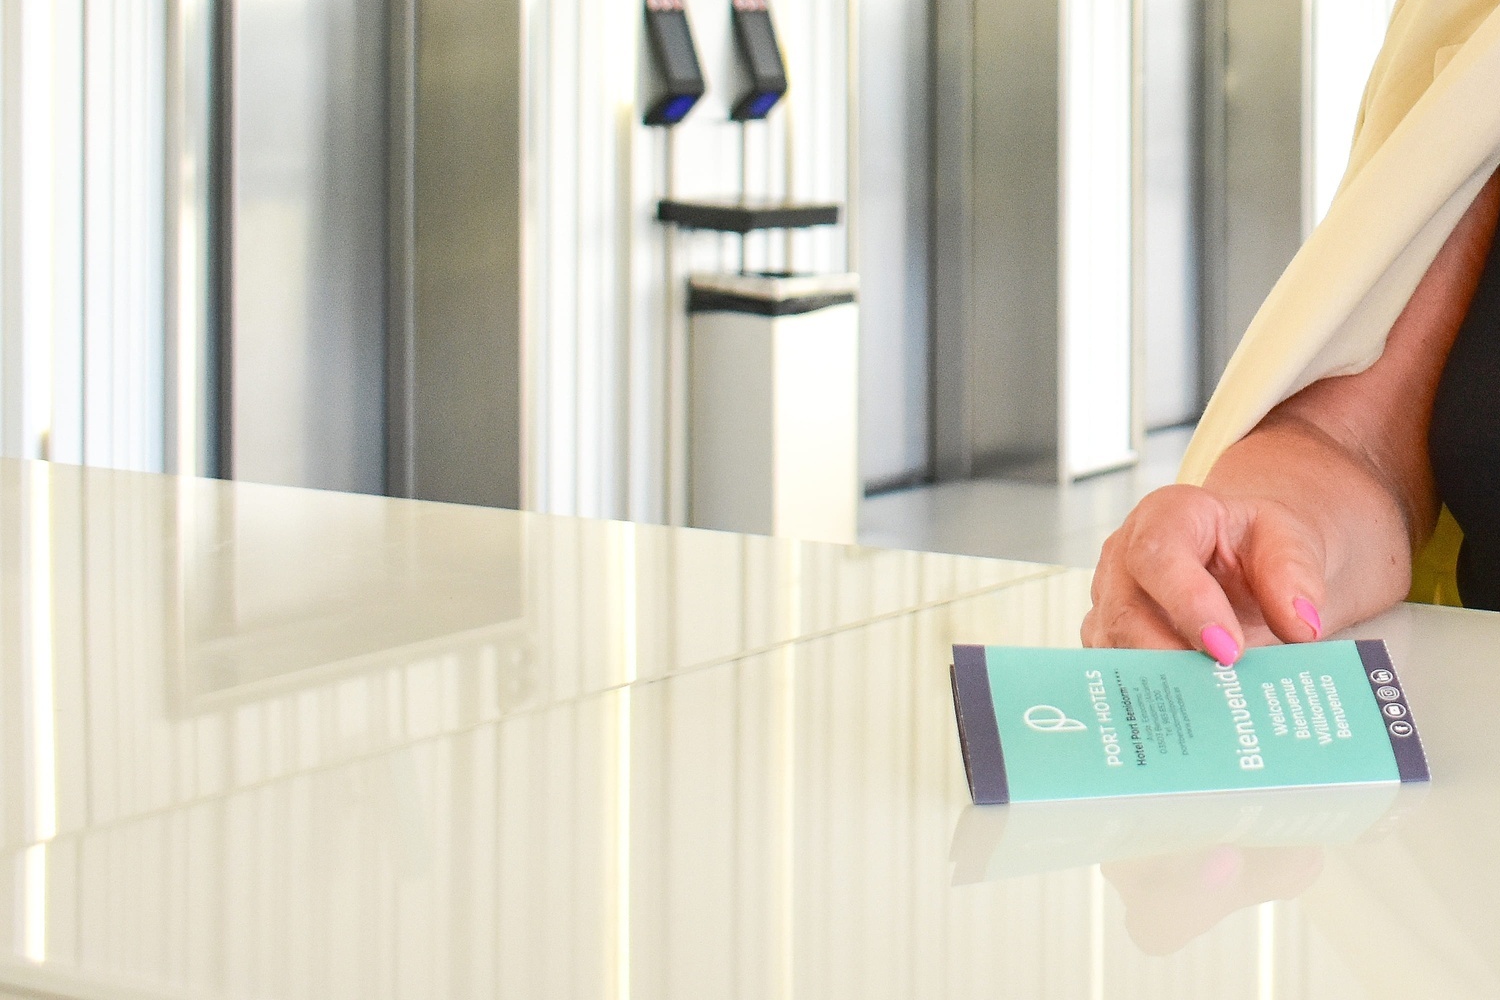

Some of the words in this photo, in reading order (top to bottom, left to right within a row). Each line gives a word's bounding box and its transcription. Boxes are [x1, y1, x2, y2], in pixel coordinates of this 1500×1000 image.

[1086, 670, 1113, 722] HOTELS
[1262, 682, 1288, 736] Welcome
[1281, 678, 1310, 738] Bienvenue
[1299, 671, 1333, 744] Willkommen
[1321, 675, 1351, 738] Benvenuto
[1100, 725, 1123, 766] PORT
[1129, 723, 1140, 740] Port
[1132, 742, 1147, 766] Hotel
